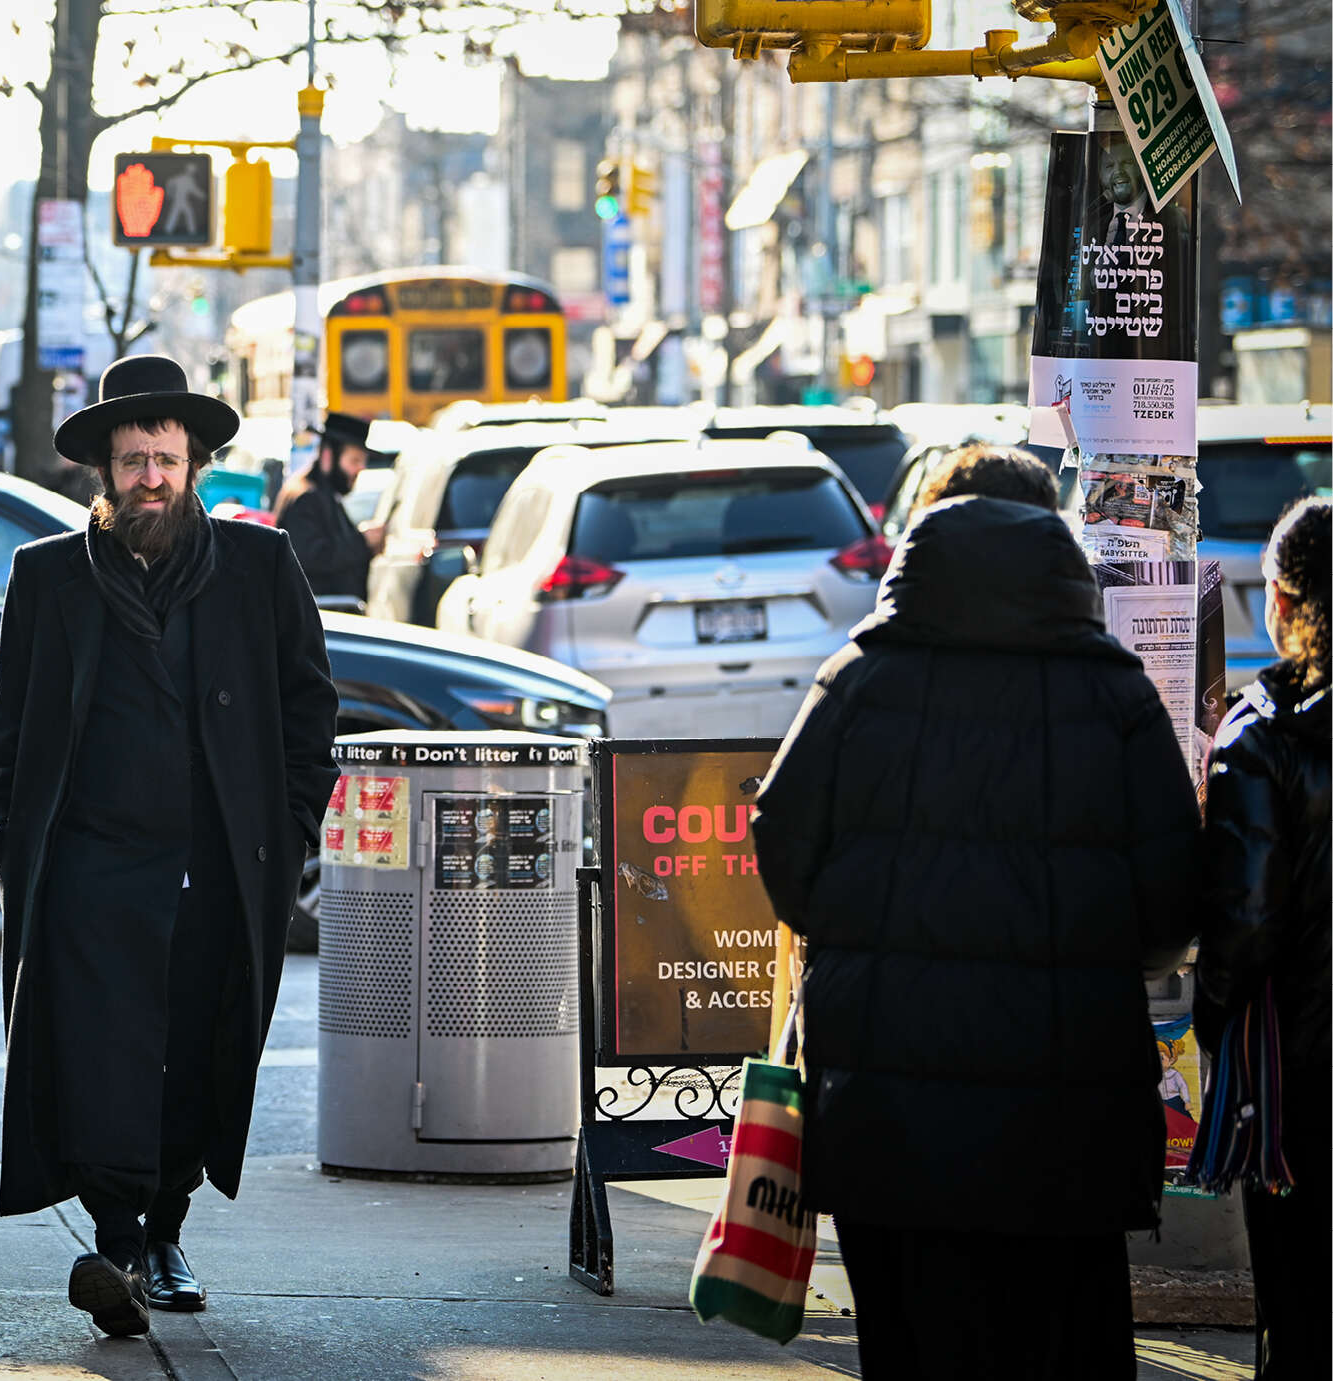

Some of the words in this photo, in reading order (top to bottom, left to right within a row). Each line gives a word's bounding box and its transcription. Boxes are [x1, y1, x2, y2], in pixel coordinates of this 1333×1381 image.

[1117, 44, 1152, 97] JUNK
[1128, 64, 1177, 140] 929
[1151, 112, 1194, 163] RESIDENTIAL
[1156, 136, 1188, 174] HOARDER
[1160, 149, 1192, 187] STORAGE
[1191, 128, 1212, 152] UNITS
[1124, 213, 1163, 242] כלל
[1094, 268, 1163, 290] פריינט
[1116, 292, 1163, 314] ביים
[1085, 308, 1163, 337] שטייסל
[1133, 410, 1174, 419] TZEDEK
[1100, 549, 1148, 558] BABYSITTER
[347, 746, 382, 761] litter
[416, 747, 467, 761] Don't
[475, 747, 519, 762] litter
[549, 748, 579, 761] Don't
[643, 805, 758, 843] COU
[654, 855, 707, 876] OFF
[658, 961, 760, 979] DESIGNER
[685, 990, 702, 1009] &
